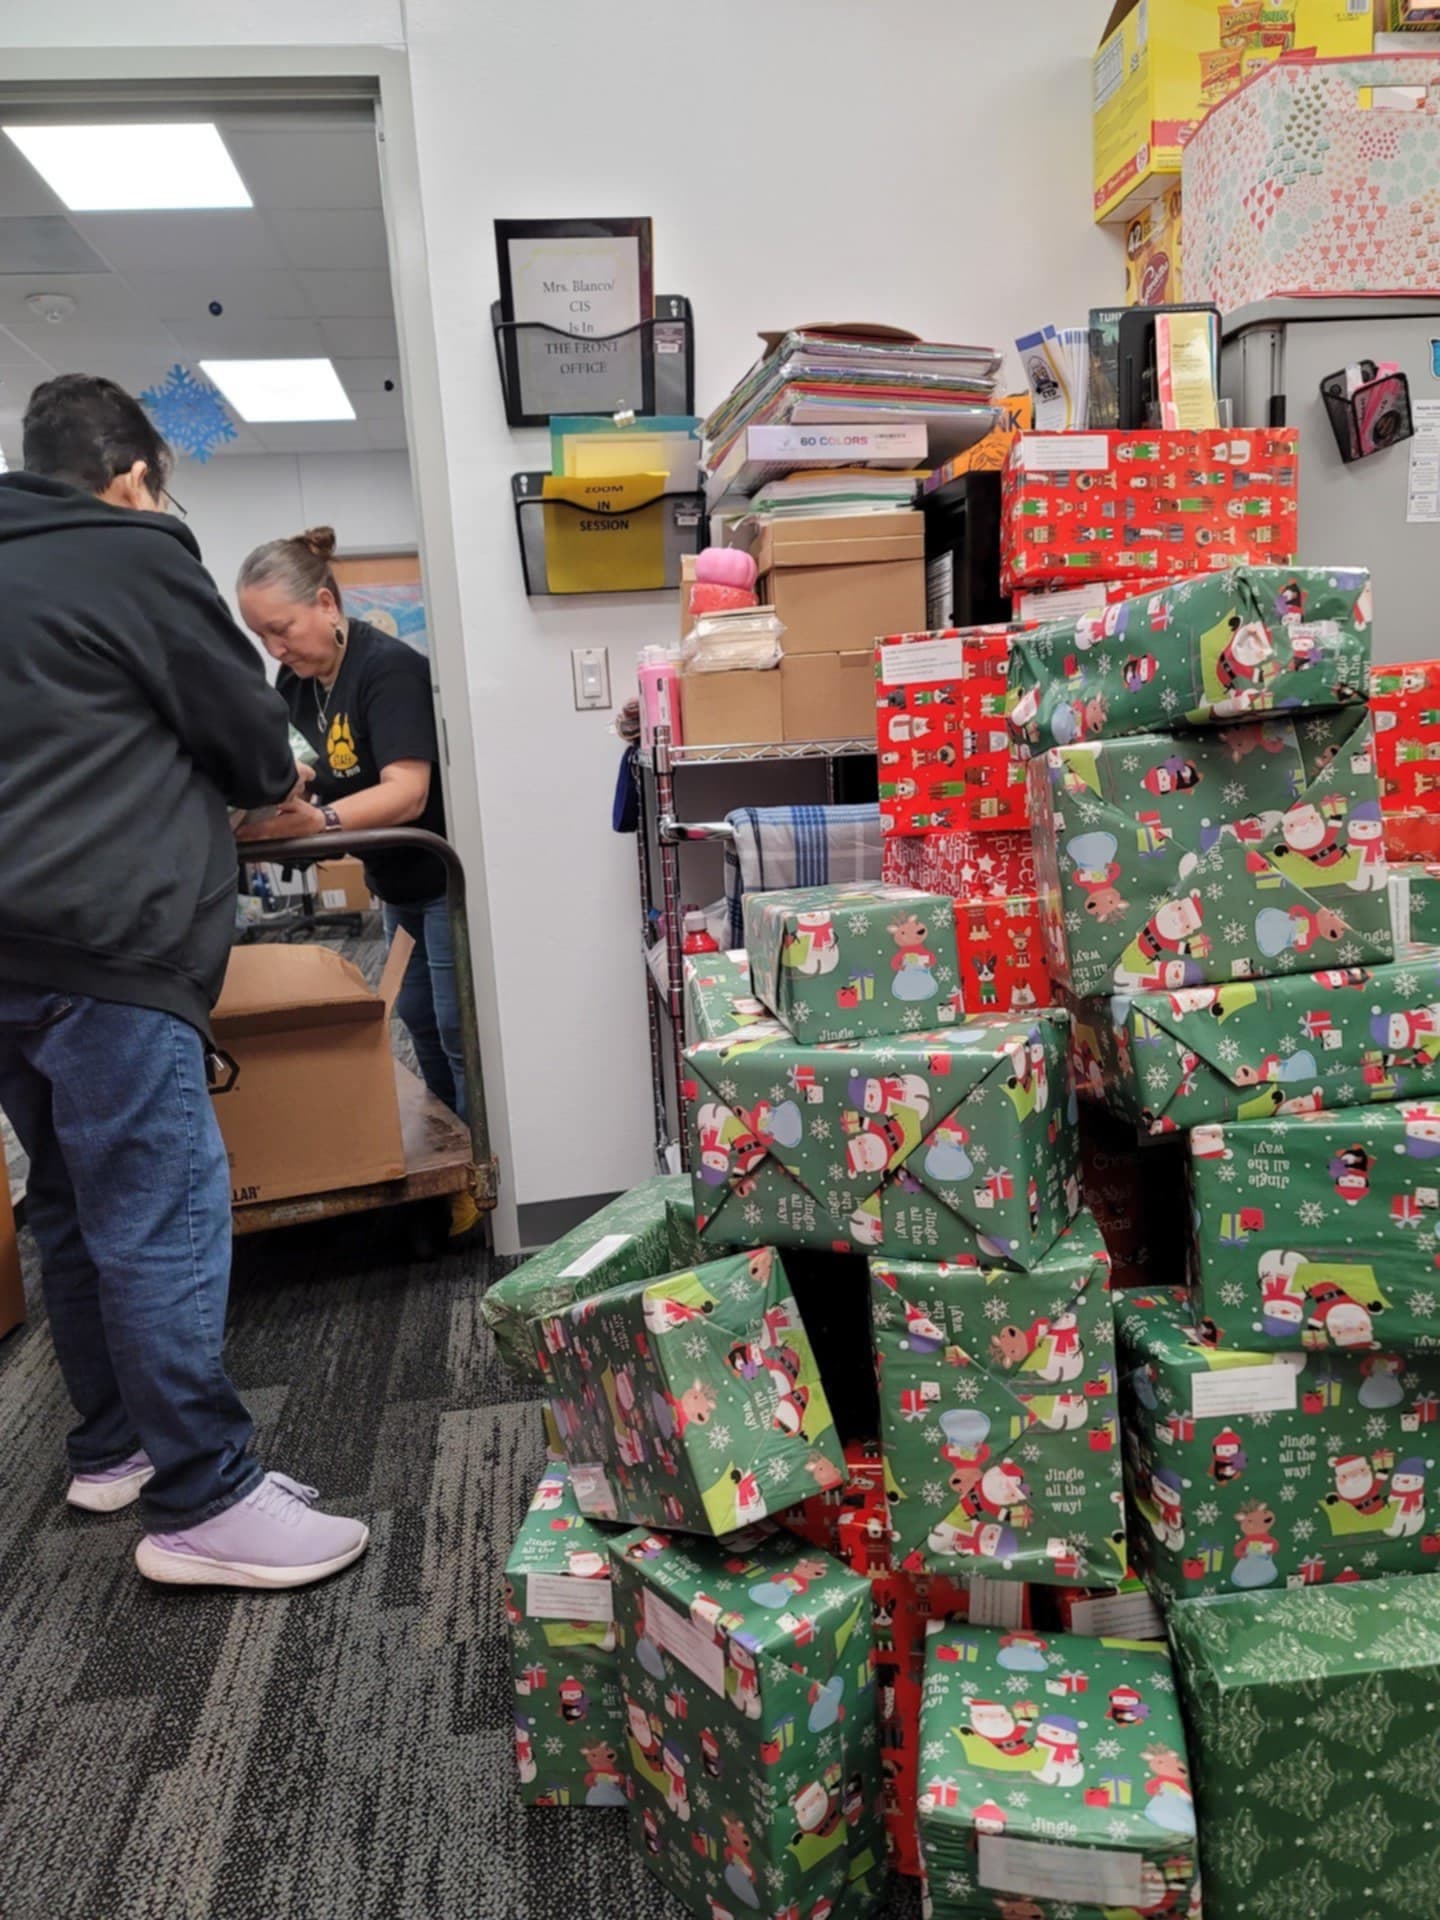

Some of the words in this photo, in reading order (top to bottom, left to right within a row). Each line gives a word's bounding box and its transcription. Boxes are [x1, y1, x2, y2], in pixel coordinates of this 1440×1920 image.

[543, 281, 569, 293] Mrs.
[569, 301, 591, 312] CIS
[569, 322, 579, 333] Is
[582, 322, 594, 332] In
[545, 343, 573, 355] THE
[574, 341, 619, 354] FRONT
[560, 361, 608, 375] OFFICE
[800, 437, 816, 446] 60
[820, 436, 869, 446] COLORS
[584, 485, 624, 494] ZOOM
[597, 501, 611, 510] IN
[580, 520, 629, 532] SESSION
[1253, 1141, 1285, 1155] way!
[1248, 1159, 1269, 1171] the
[1273, 1159, 1290, 1172] all
[1248, 1172, 1290, 1189] Jingle
[231, 1186, 259, 1201] LAR
[791, 1192, 803, 1208] all
[776, 1196, 790, 1225] way!
[910, 1206, 923, 1221] all
[792, 1212, 802, 1231] the
[894, 1210, 909, 1239] way!
[924, 1207, 938, 1246] Jingle
[911, 1225, 923, 1245] the
[933, 1300, 944, 1319] the
[947, 1305, 965, 1334] way!
[754, 1391, 769, 1408] all
[743, 1400, 760, 1431] way!
[1279, 1434, 1316, 1449] Jingle
[1279, 1451, 1295, 1463] all
[1297, 1450, 1316, 1462] the
[1045, 1467, 1084, 1483] Jingle
[1284, 1464, 1312, 1478] way!
[1045, 1484, 1063, 1496] all
[1065, 1484, 1086, 1496] the
[1052, 1499, 1082, 1513] way!
[525, 1538, 557, 1546] Jingle
[928, 1684, 949, 1695] the
[1032, 1816, 1077, 1839] Jingle
